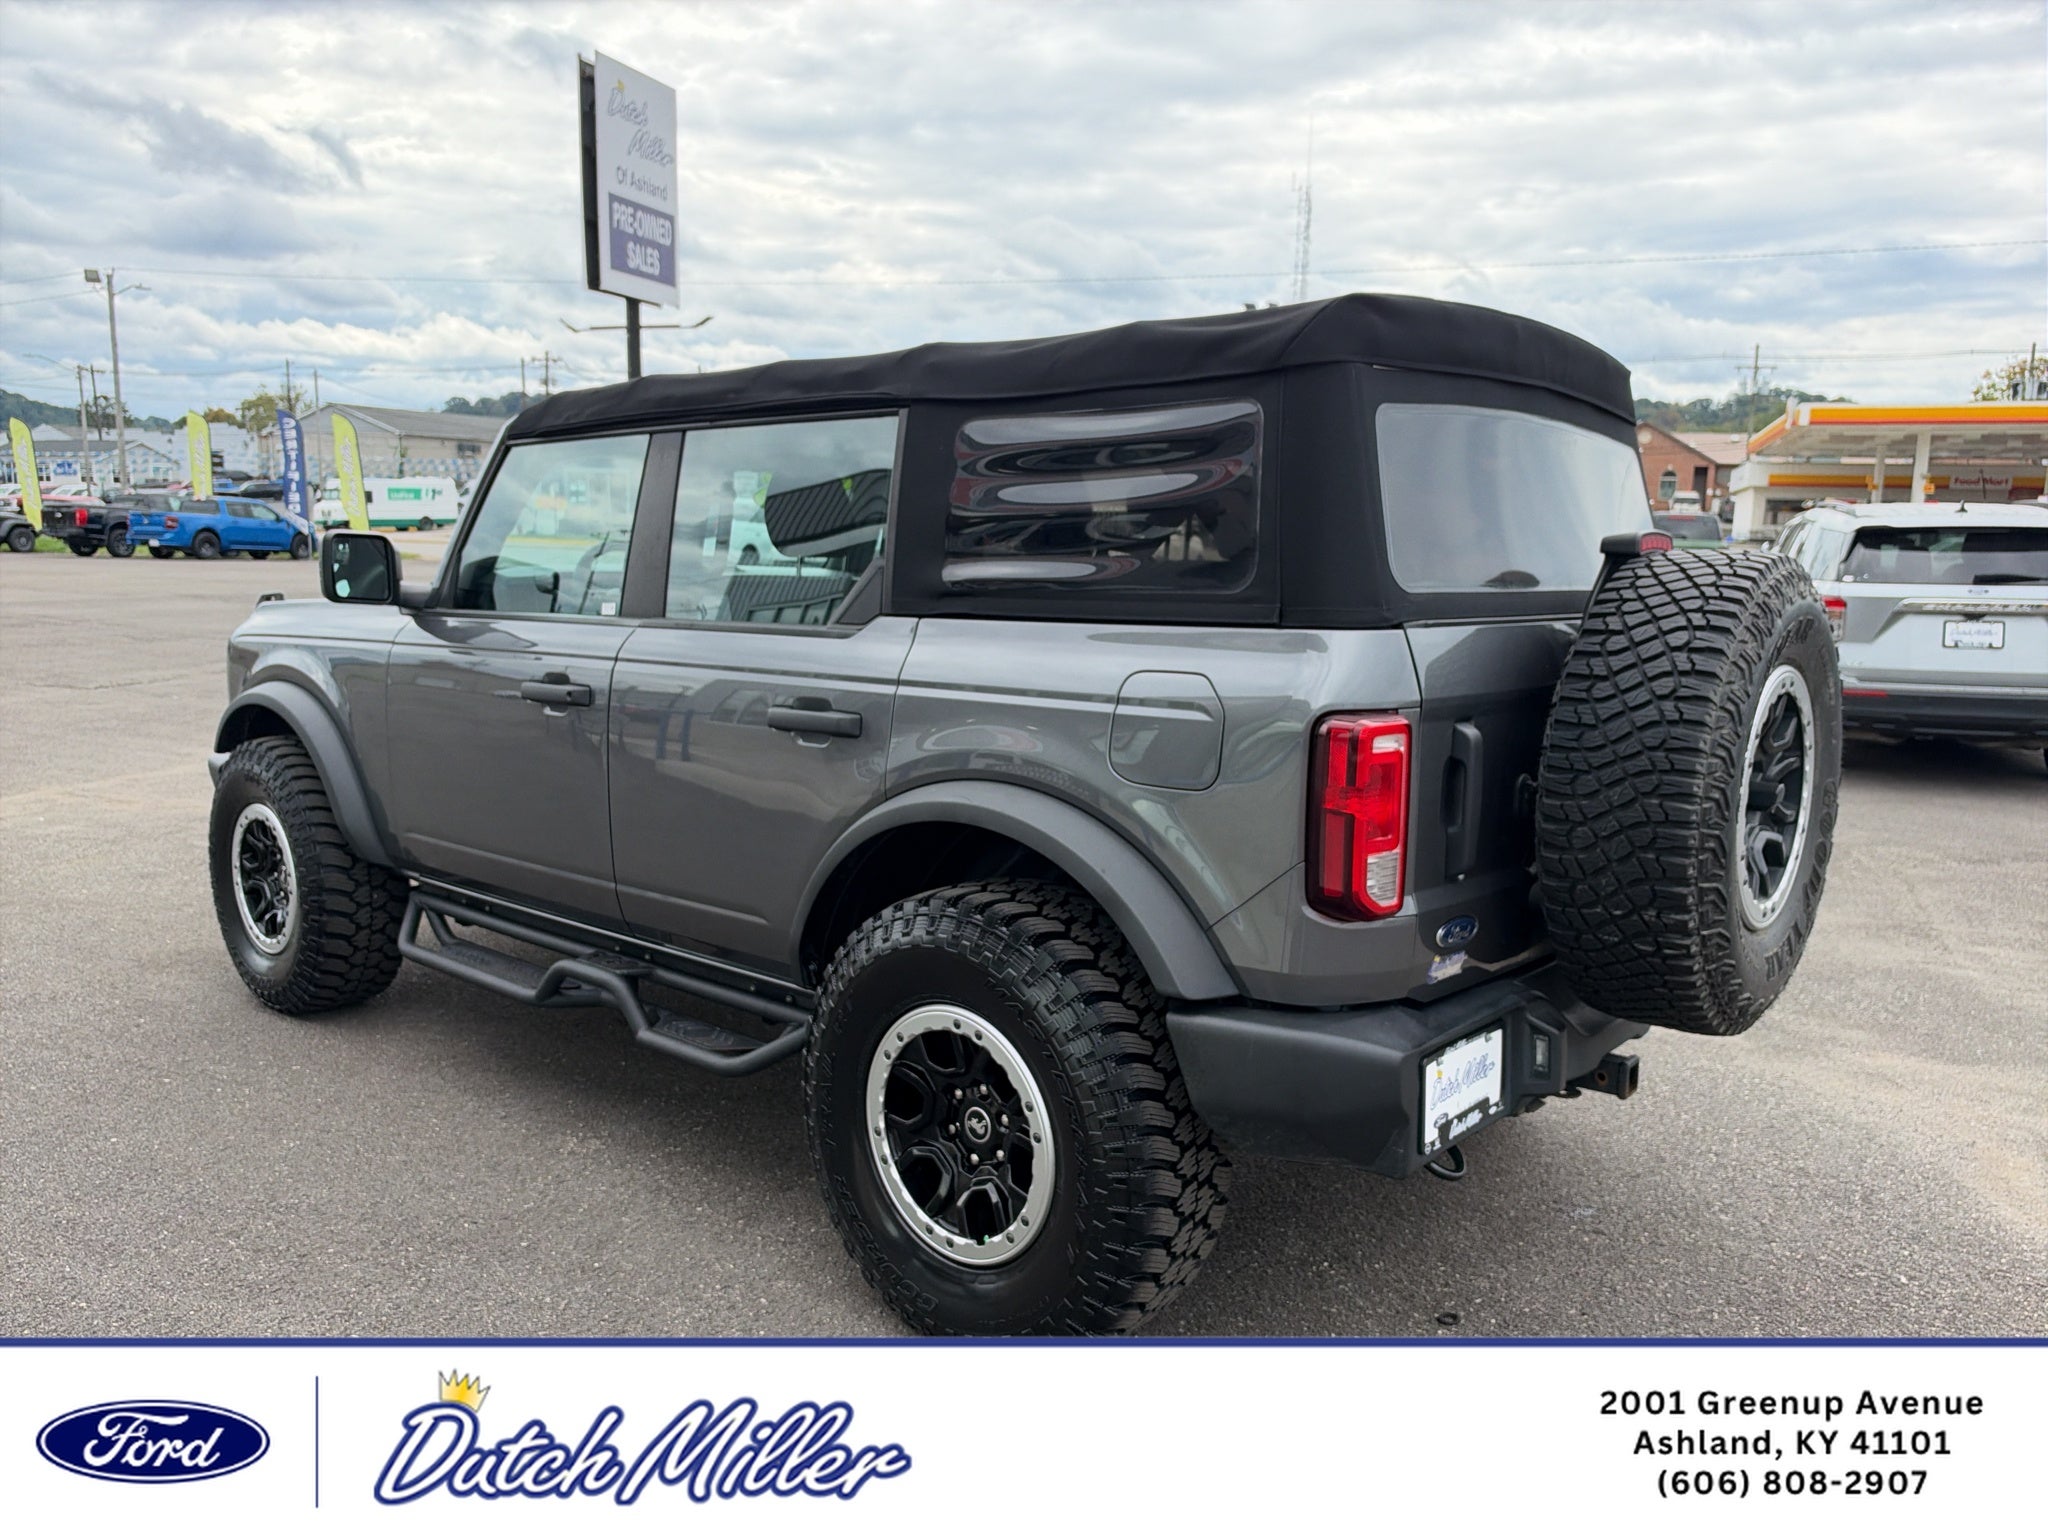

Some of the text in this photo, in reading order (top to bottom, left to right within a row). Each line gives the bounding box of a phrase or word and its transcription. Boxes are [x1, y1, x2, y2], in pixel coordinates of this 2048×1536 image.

[607, 84, 649, 127] Dutch
[628, 127, 674, 168] Miller
[616, 165, 668, 202] Of Ashland
[612, 201, 673, 247] PRE-OWNED
[626, 241, 660, 276] SALES
[1954, 476, 2009, 486] Food Mart
